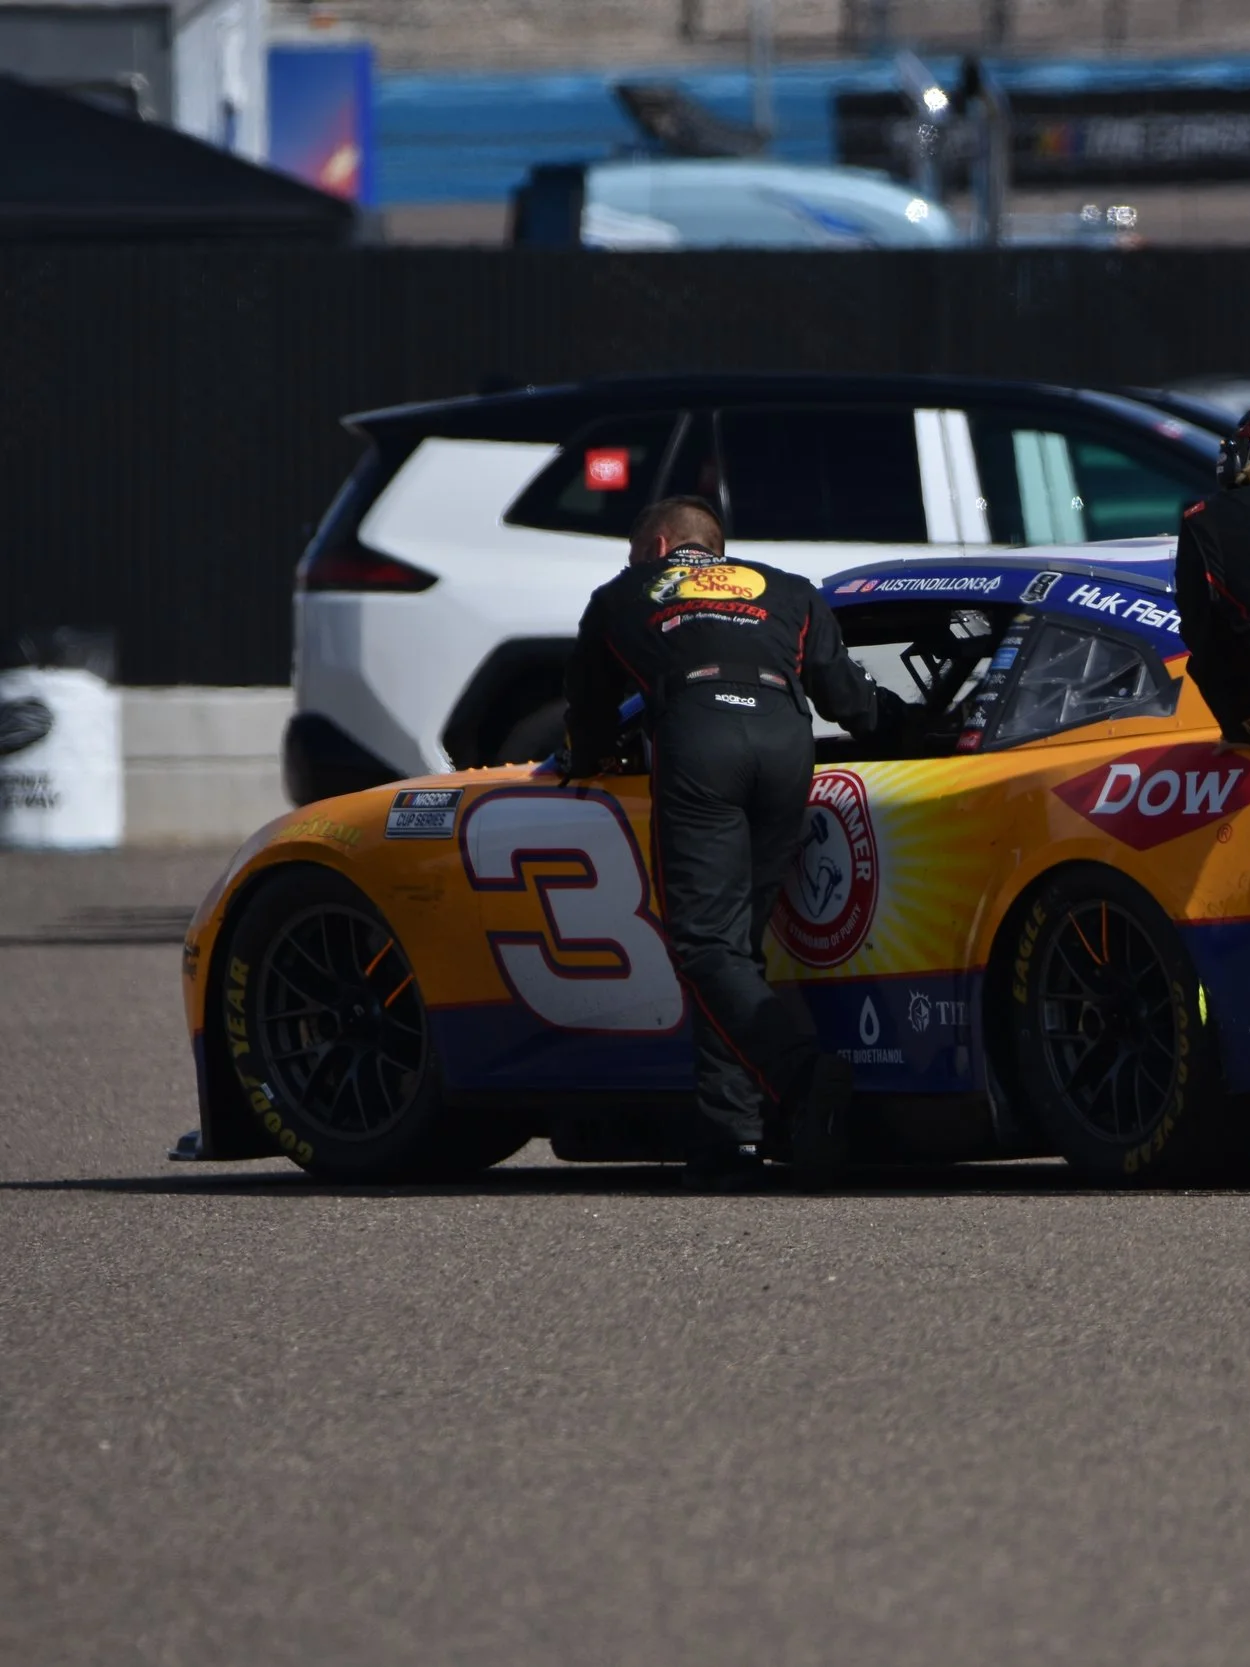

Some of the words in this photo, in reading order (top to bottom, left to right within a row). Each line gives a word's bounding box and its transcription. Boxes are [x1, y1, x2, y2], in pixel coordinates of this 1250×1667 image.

[693, 581, 754, 599] Shops
[732, 615, 760, 625] Legend
[1121, 599, 1181, 634] Fish
[412, 792, 453, 807] NASCAR
[396, 812, 416, 827] CUP
[414, 812, 446, 827] SERIES
[809, 777, 872, 883] HAMMER
[458, 786, 688, 1036] 3
[1012, 900, 1048, 1005] EAGLE
[852, 1048, 905, 1065] BIOETHANOL
